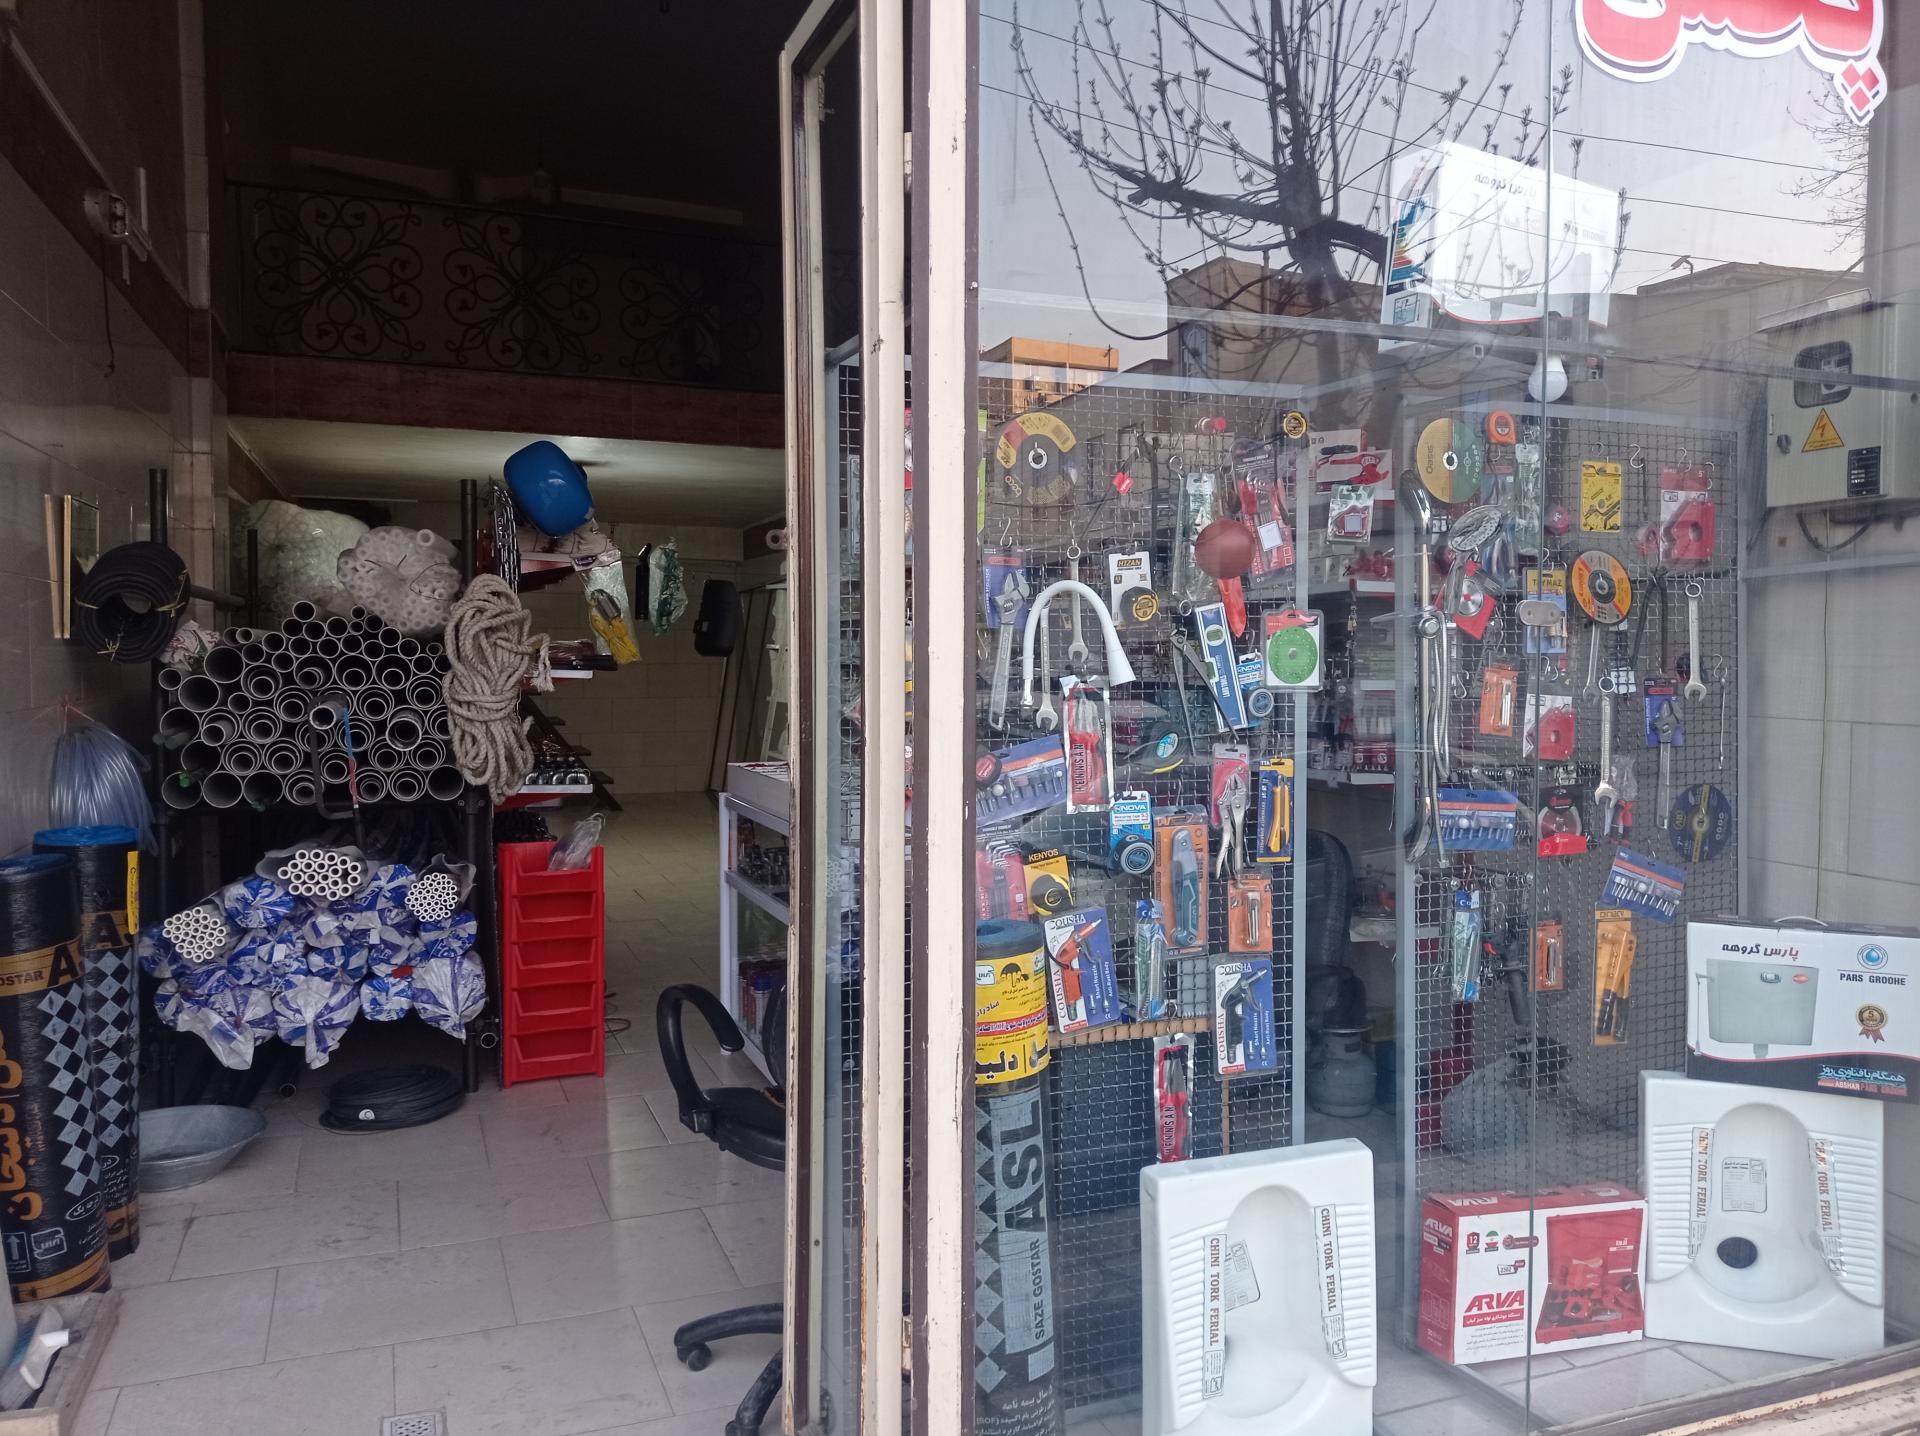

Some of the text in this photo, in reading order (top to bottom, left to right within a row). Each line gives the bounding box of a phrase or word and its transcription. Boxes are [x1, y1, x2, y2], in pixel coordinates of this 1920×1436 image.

[1028, 849, 1058, 862] KENYOS
[1049, 914, 1086, 930] COUSHA
[1722, 943, 1799, 962] پارس گروهه
[1219, 963, 1252, 975] COUSHA
[1840, 973, 1906, 986] PARS GROOHE
[1053, 969, 1065, 1018] COUSHA
[1217, 1013, 1226, 1060] COUSHA
[1835, 1081, 1860, 1090] ABSHAR
[1000, 1100, 1047, 1232] ASL
[1697, 1160, 1708, 1183] TORK
[1696, 1187, 1707, 1218] FERIAL
[1820, 1199, 1832, 1231] FERIAL
[1424, 1218, 1453, 1238] ARVA
[1470, 1236, 1478, 1244] 12
[1210, 1238, 1220, 1267] CHINI
[1321, 1208, 1337, 1312] CHINI TORK FERIAL
[1030, 1239, 1045, 1341] SAZE GOSTAR
[1210, 1272, 1220, 1302] TORK
[1464, 1290, 1524, 1313] ARVA
[1210, 1308, 1220, 1346] FERIAL
